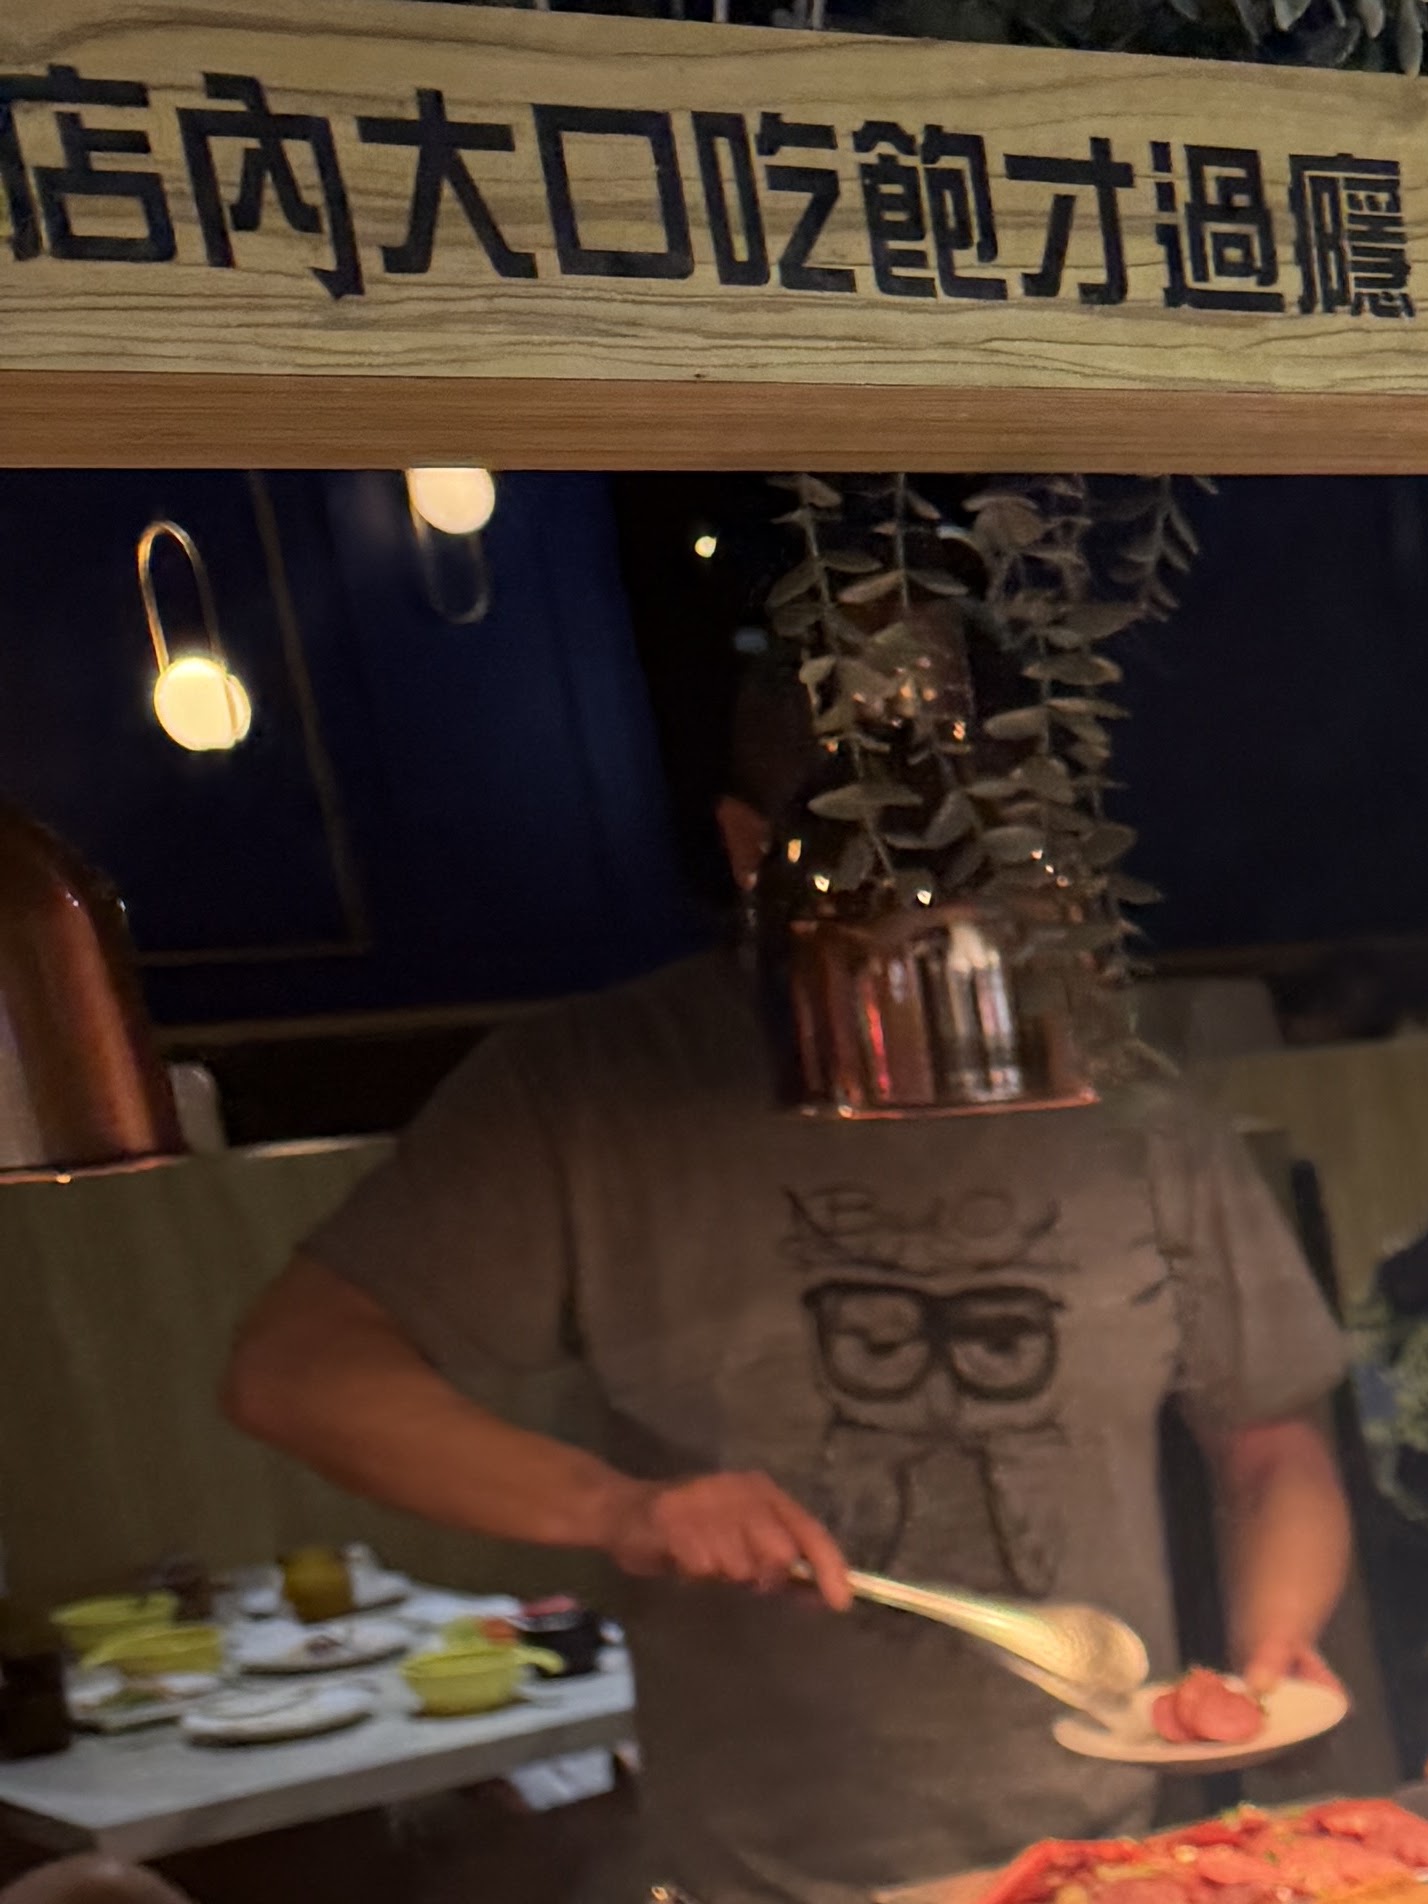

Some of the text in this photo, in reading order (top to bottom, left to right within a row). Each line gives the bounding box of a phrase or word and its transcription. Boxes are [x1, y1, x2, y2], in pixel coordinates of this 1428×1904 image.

[0, 63, 1416, 318] 店內大口吃飽才過癮
